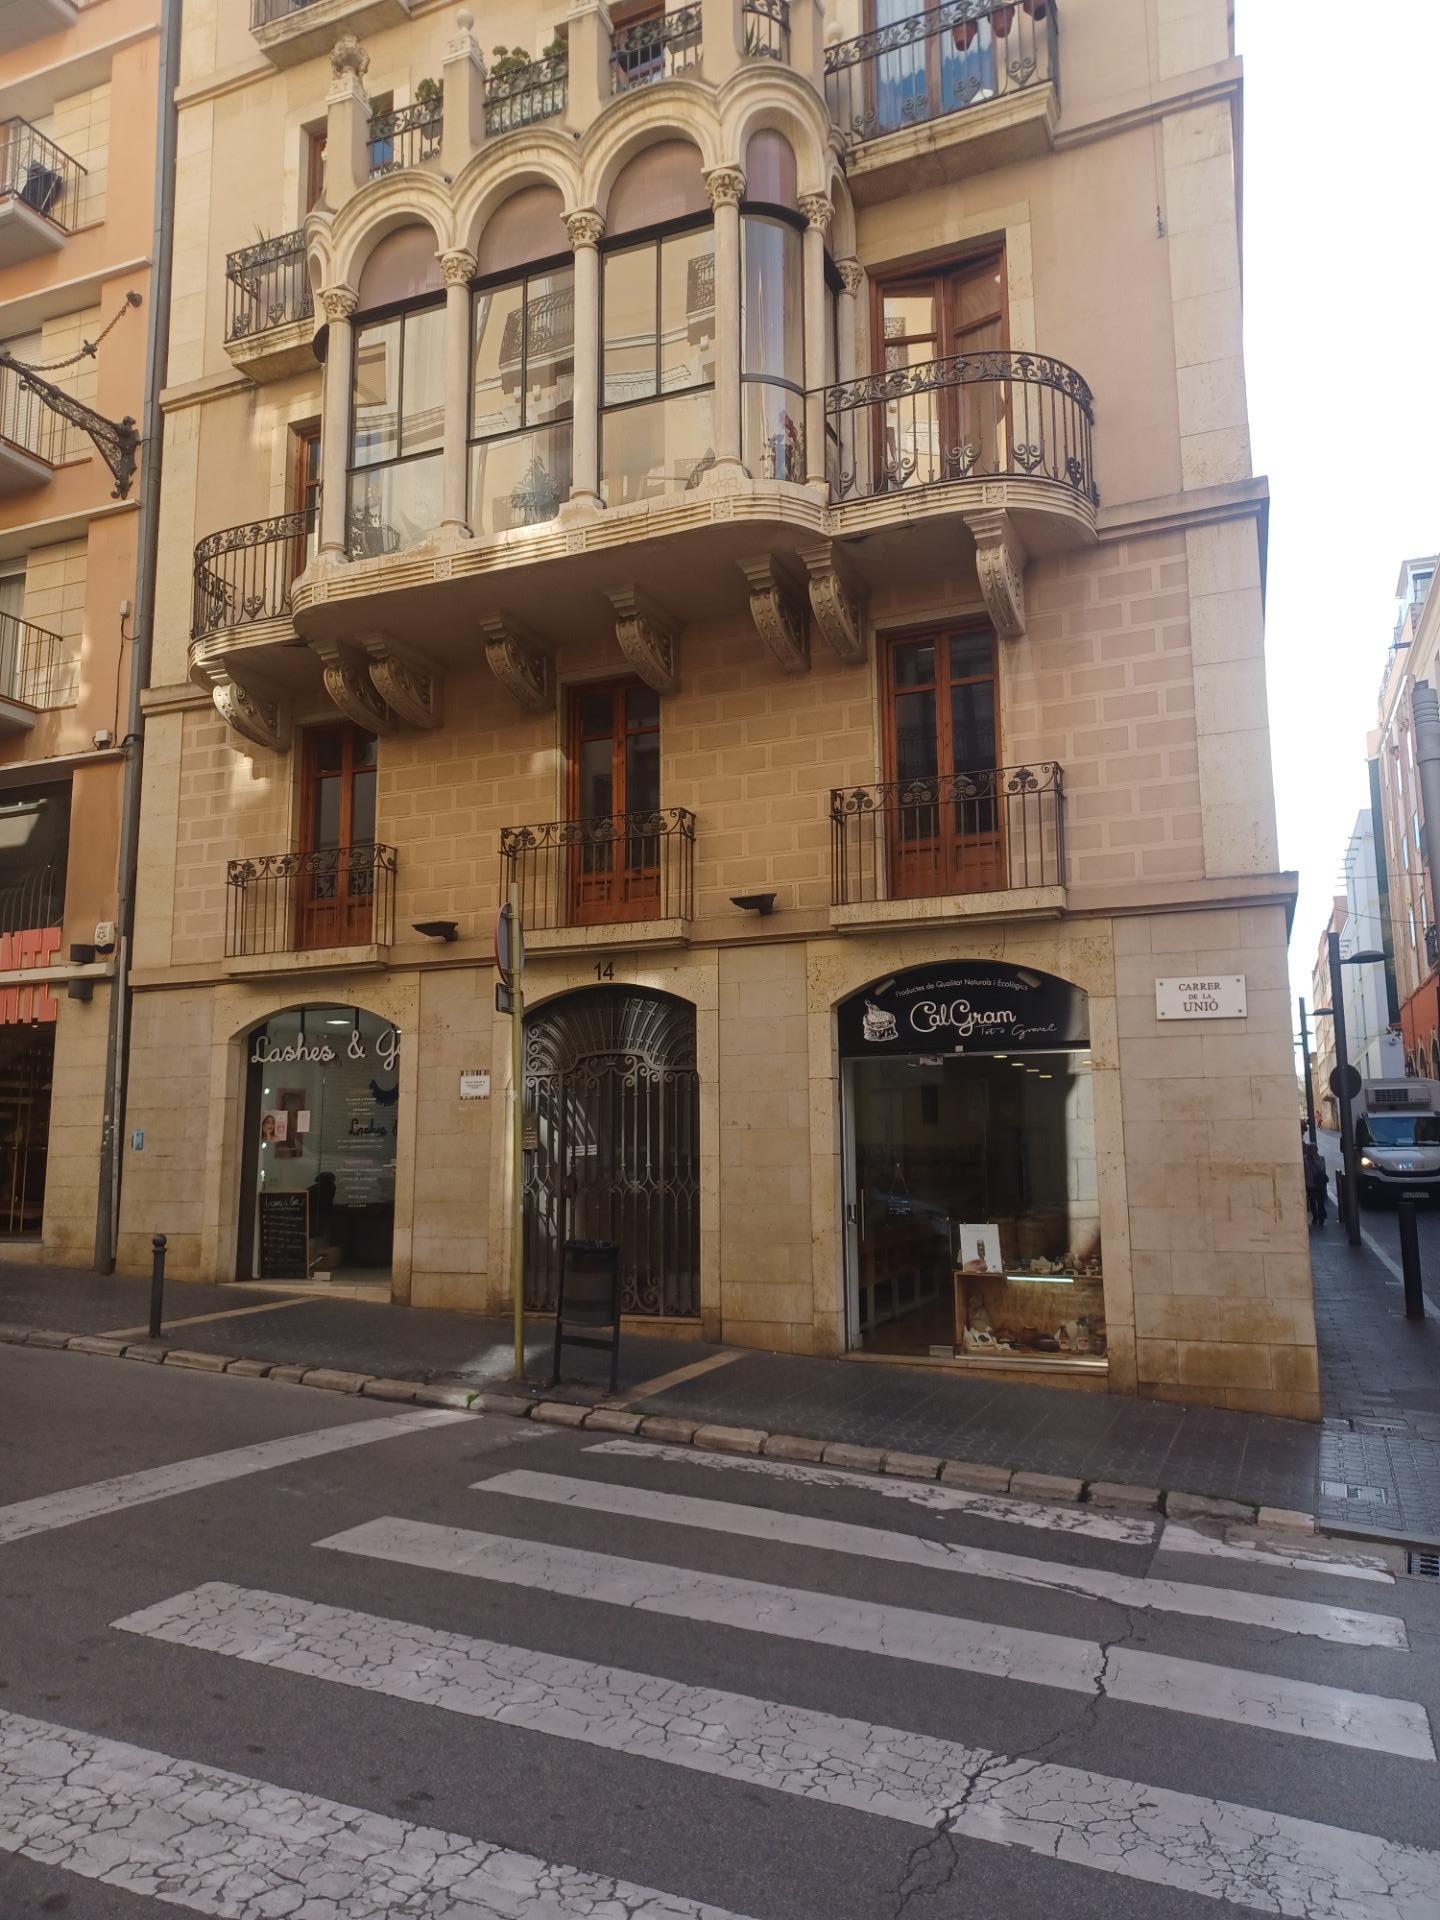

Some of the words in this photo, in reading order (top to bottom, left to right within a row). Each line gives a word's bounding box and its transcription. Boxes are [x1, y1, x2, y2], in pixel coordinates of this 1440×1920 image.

[593, 962, 615, 981] 14
[964, 978, 992, 986] Naturals
[1178, 982, 1221, 991] CARRER
[1183, 998, 1219, 1012] UNIÓ
[251, 1031, 336, 1064] Lashes
[347, 1030, 366, 1059] &
